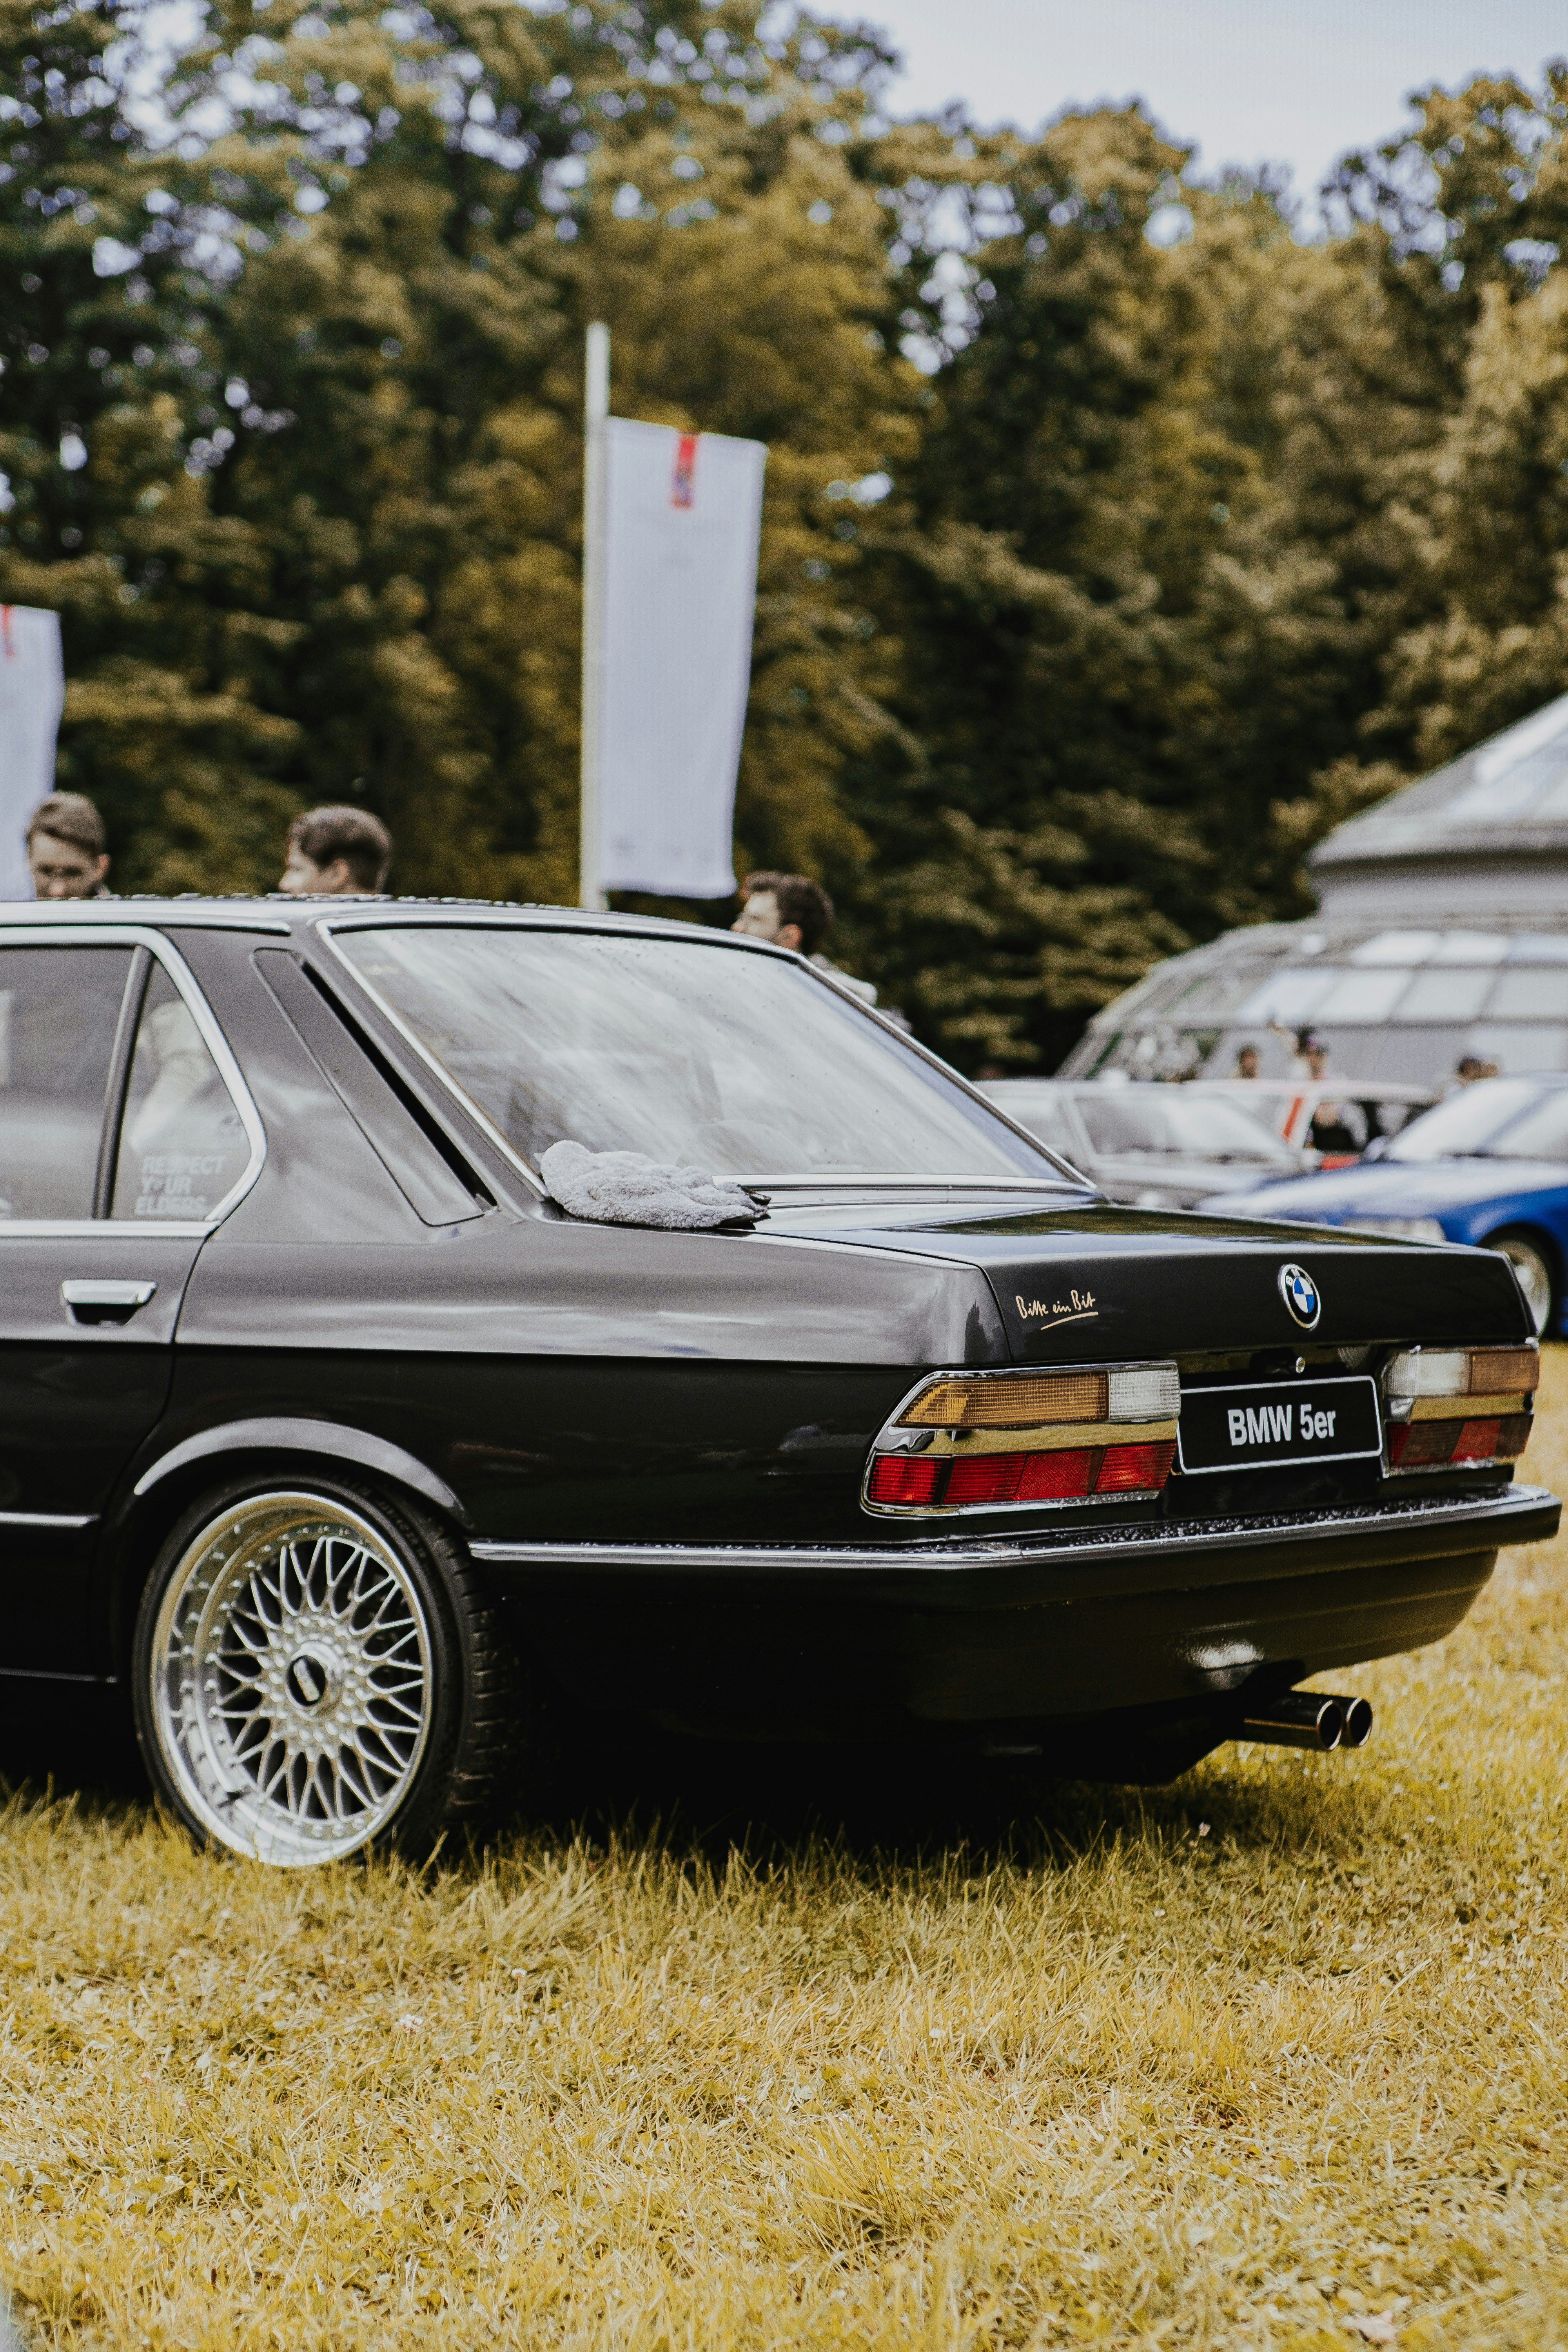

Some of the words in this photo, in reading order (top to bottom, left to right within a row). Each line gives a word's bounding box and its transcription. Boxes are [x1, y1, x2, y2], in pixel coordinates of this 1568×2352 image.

[142, 1155, 226, 1174] RESPECT
[1016, 1296, 1049, 1319] Bitte
[1053, 1301, 1071, 1313] ein
[1071, 1290, 1096, 1310] Bit
[1228, 1404, 1292, 1446] BMW
[1300, 1403, 1336, 1440] 5er
